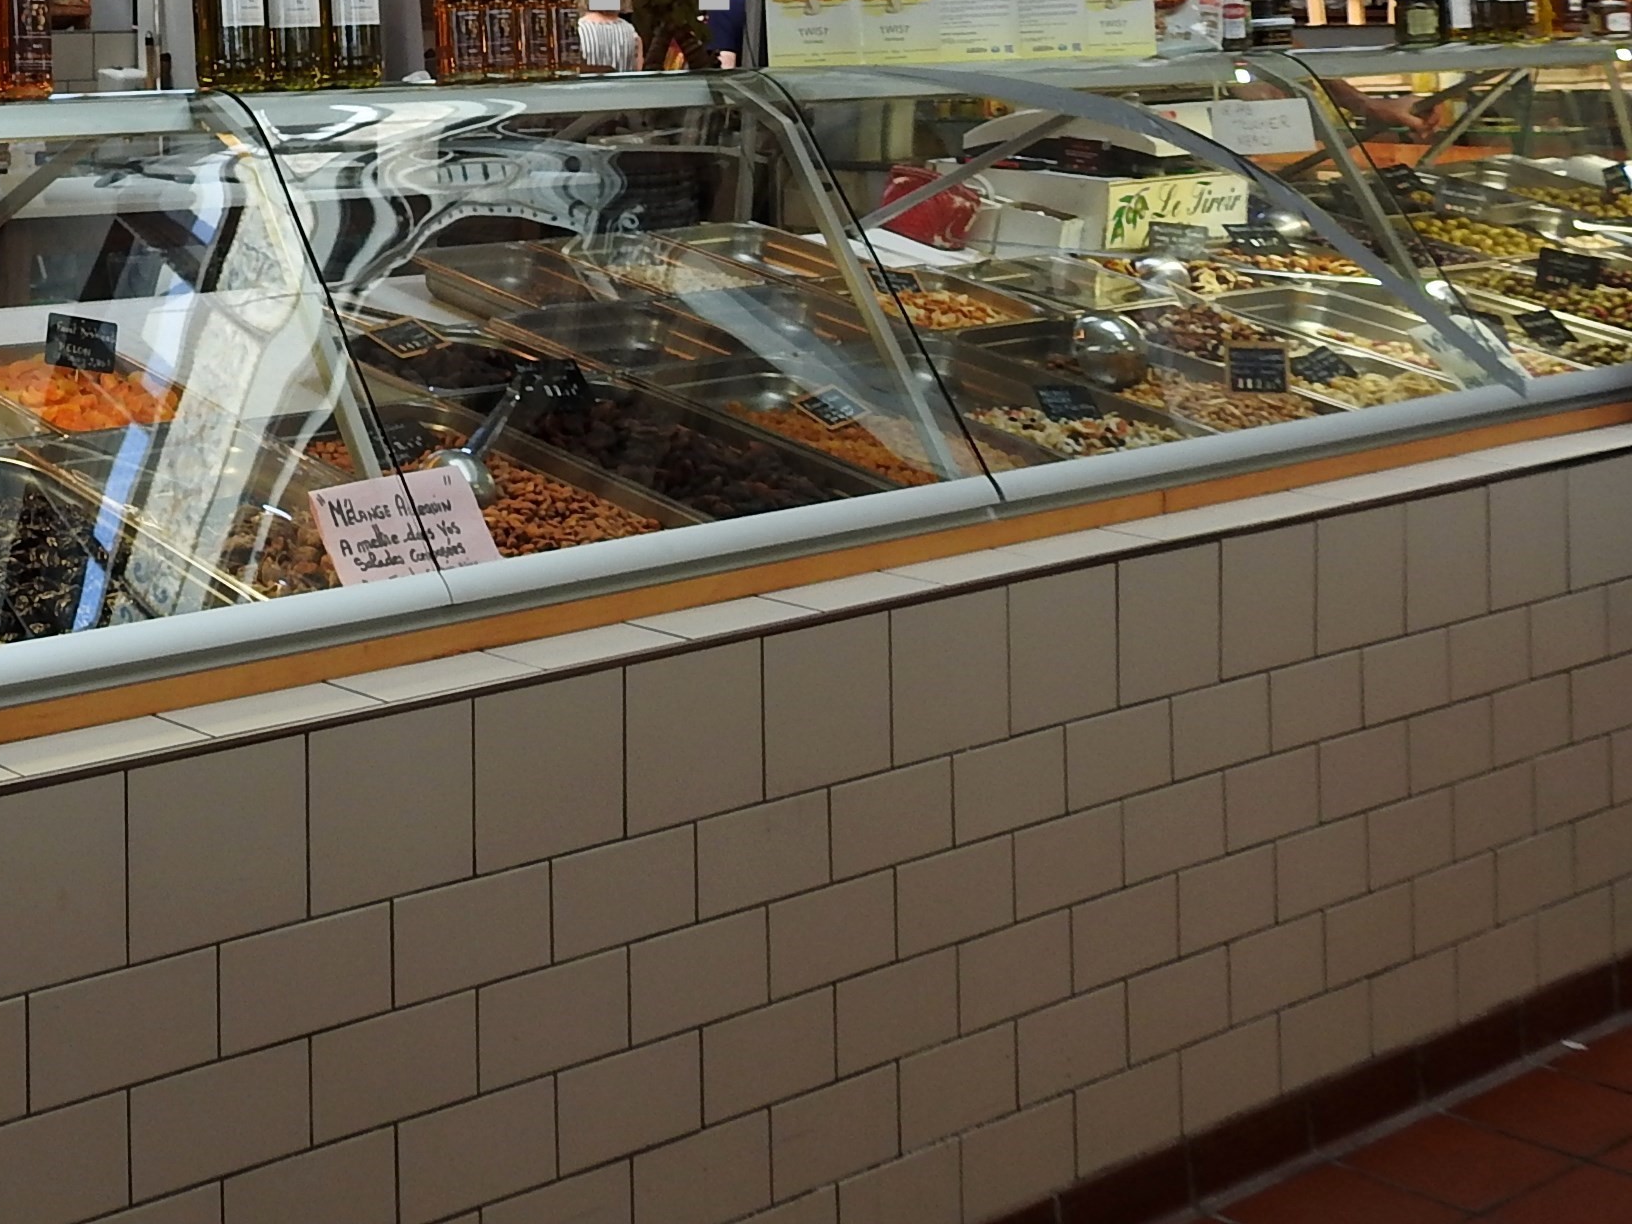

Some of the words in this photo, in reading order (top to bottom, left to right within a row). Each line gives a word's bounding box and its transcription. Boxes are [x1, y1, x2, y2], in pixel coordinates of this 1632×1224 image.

[798, 26, 829, 37] TWIST
[879, 25, 910, 35] TWIST
[1159, 183, 1181, 217] Le
[1187, 187, 1241, 216] Tiroir
[340, 539, 353, 556] A
